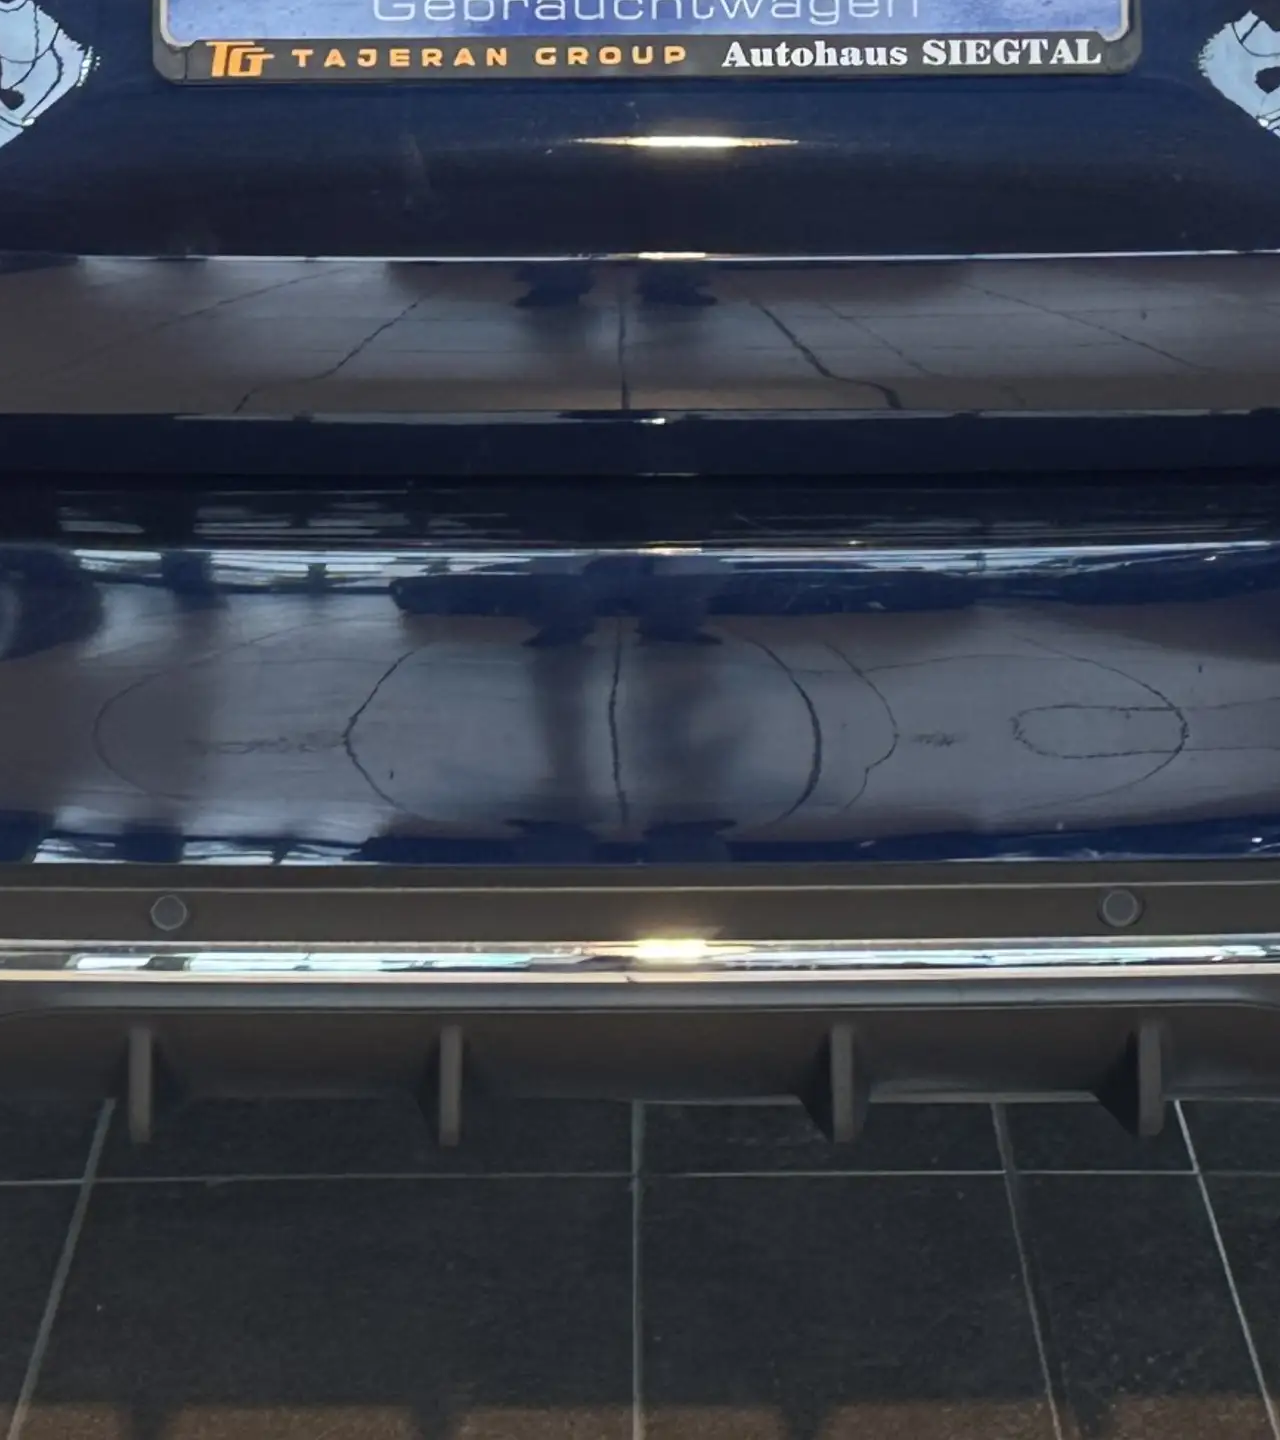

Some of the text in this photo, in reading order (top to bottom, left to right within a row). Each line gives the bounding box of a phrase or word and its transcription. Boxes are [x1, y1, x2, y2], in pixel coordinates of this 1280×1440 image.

[291, 47, 508, 68] TAJERAN
[534, 46, 687, 66] GROUP
[721, 40, 909, 68] Autohaus
[921, 38, 1101, 67] SIEGTAL
